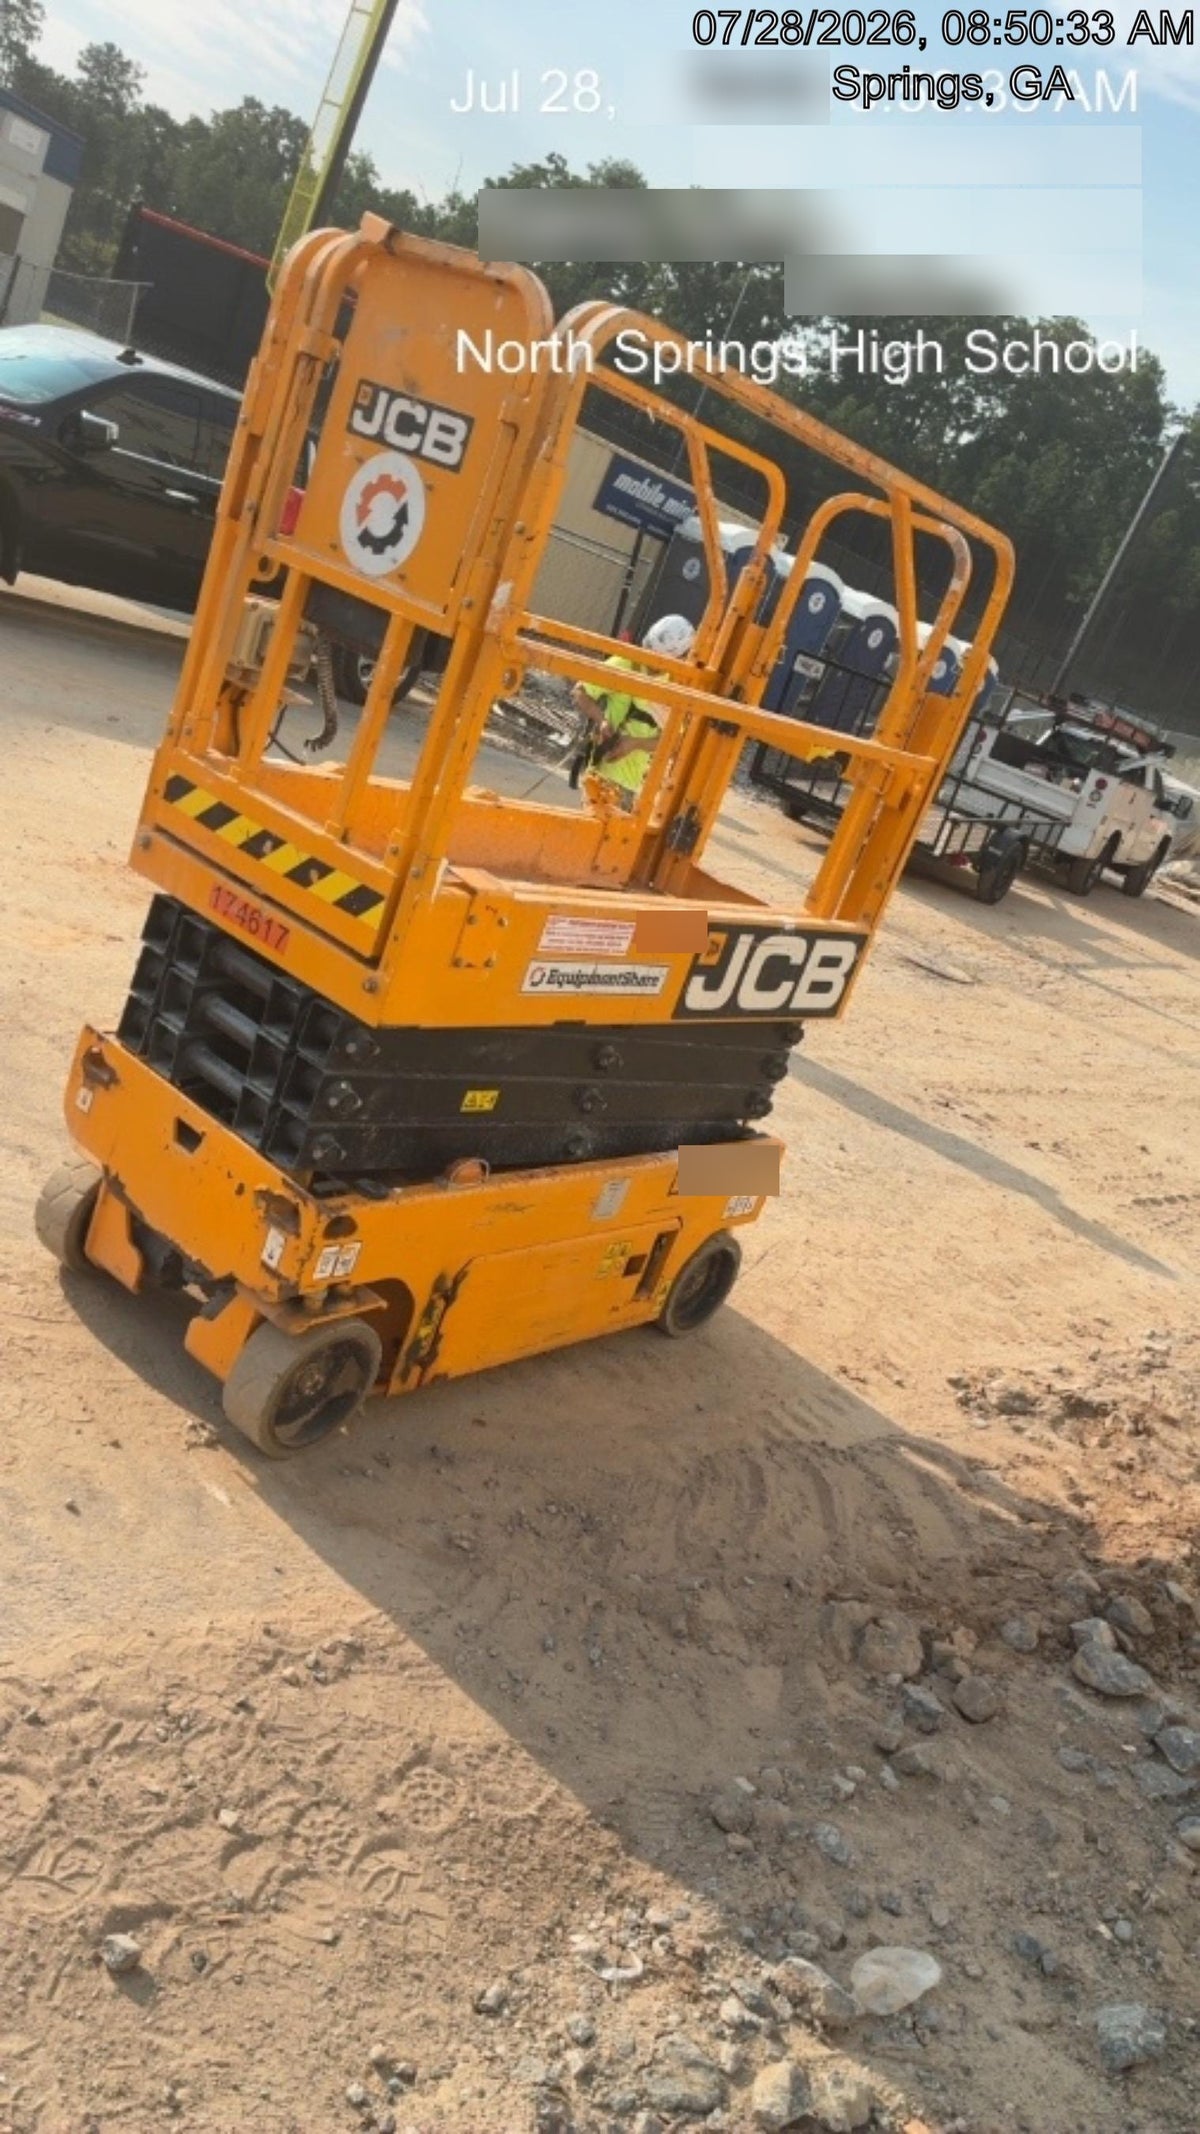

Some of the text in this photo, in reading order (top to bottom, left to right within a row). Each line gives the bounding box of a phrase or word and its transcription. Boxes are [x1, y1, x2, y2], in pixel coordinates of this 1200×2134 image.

[352, 389, 468, 466] JCB
[613, 473, 665, 508] mobile
[210, 886, 291, 951] 174617
[547, 968, 660, 990] EquipmentShare
[685, 933, 858, 1011] JCB
